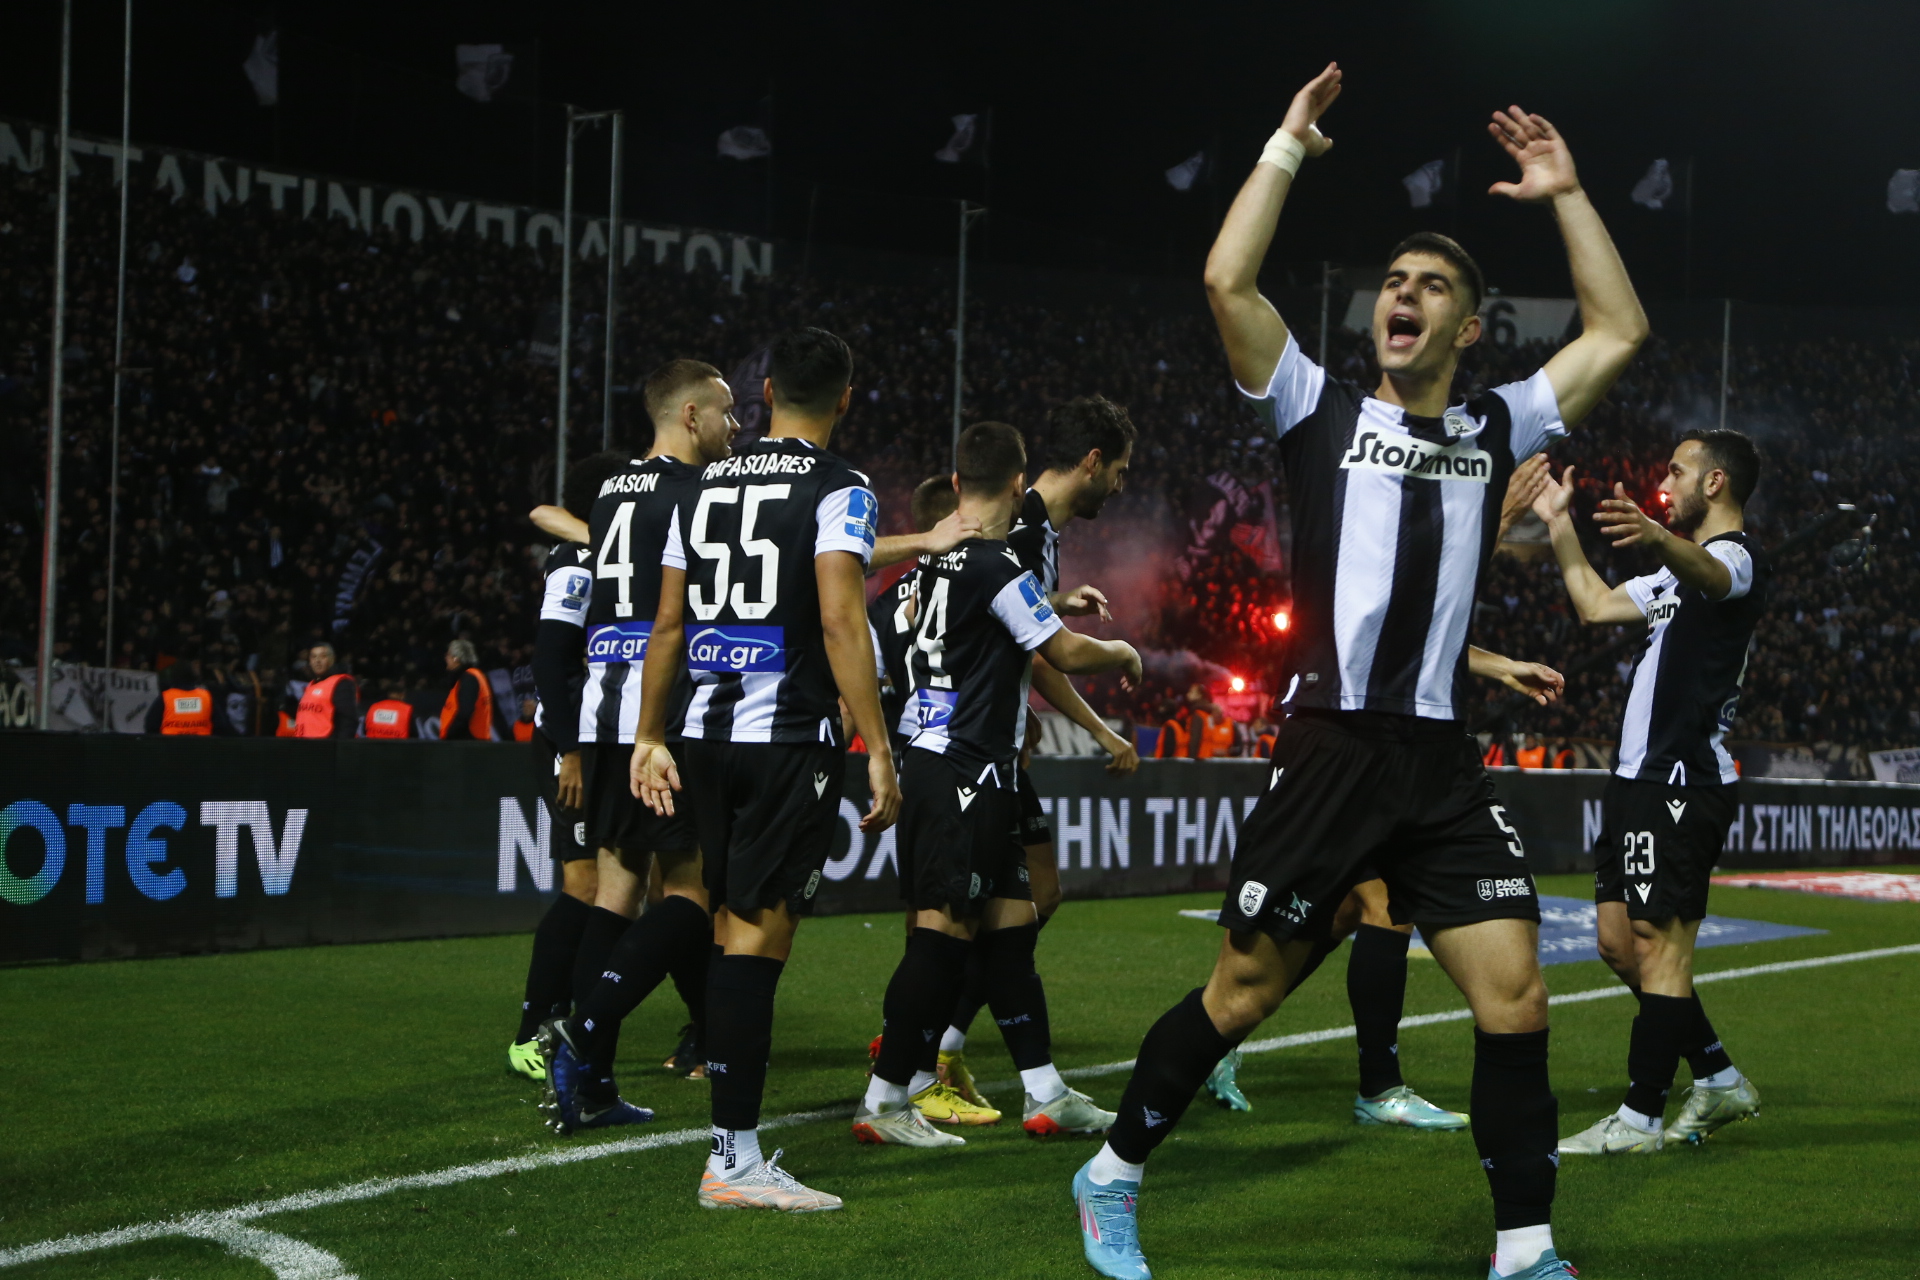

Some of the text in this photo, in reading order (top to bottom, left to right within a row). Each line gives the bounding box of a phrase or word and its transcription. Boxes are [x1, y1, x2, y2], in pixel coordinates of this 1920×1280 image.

[702, 453, 816, 481] RAFASOARES
[597, 501, 636, 617] 4
[688, 484, 792, 621] 55
[689, 628, 766, 669] car.gr
[200, 801, 309, 898] TV
[1490, 804, 1524, 857] 5
[1624, 830, 1655, 875] 23
[1495, 878, 1526, 888] PAOK
[1496, 887, 1530, 897] STORE
